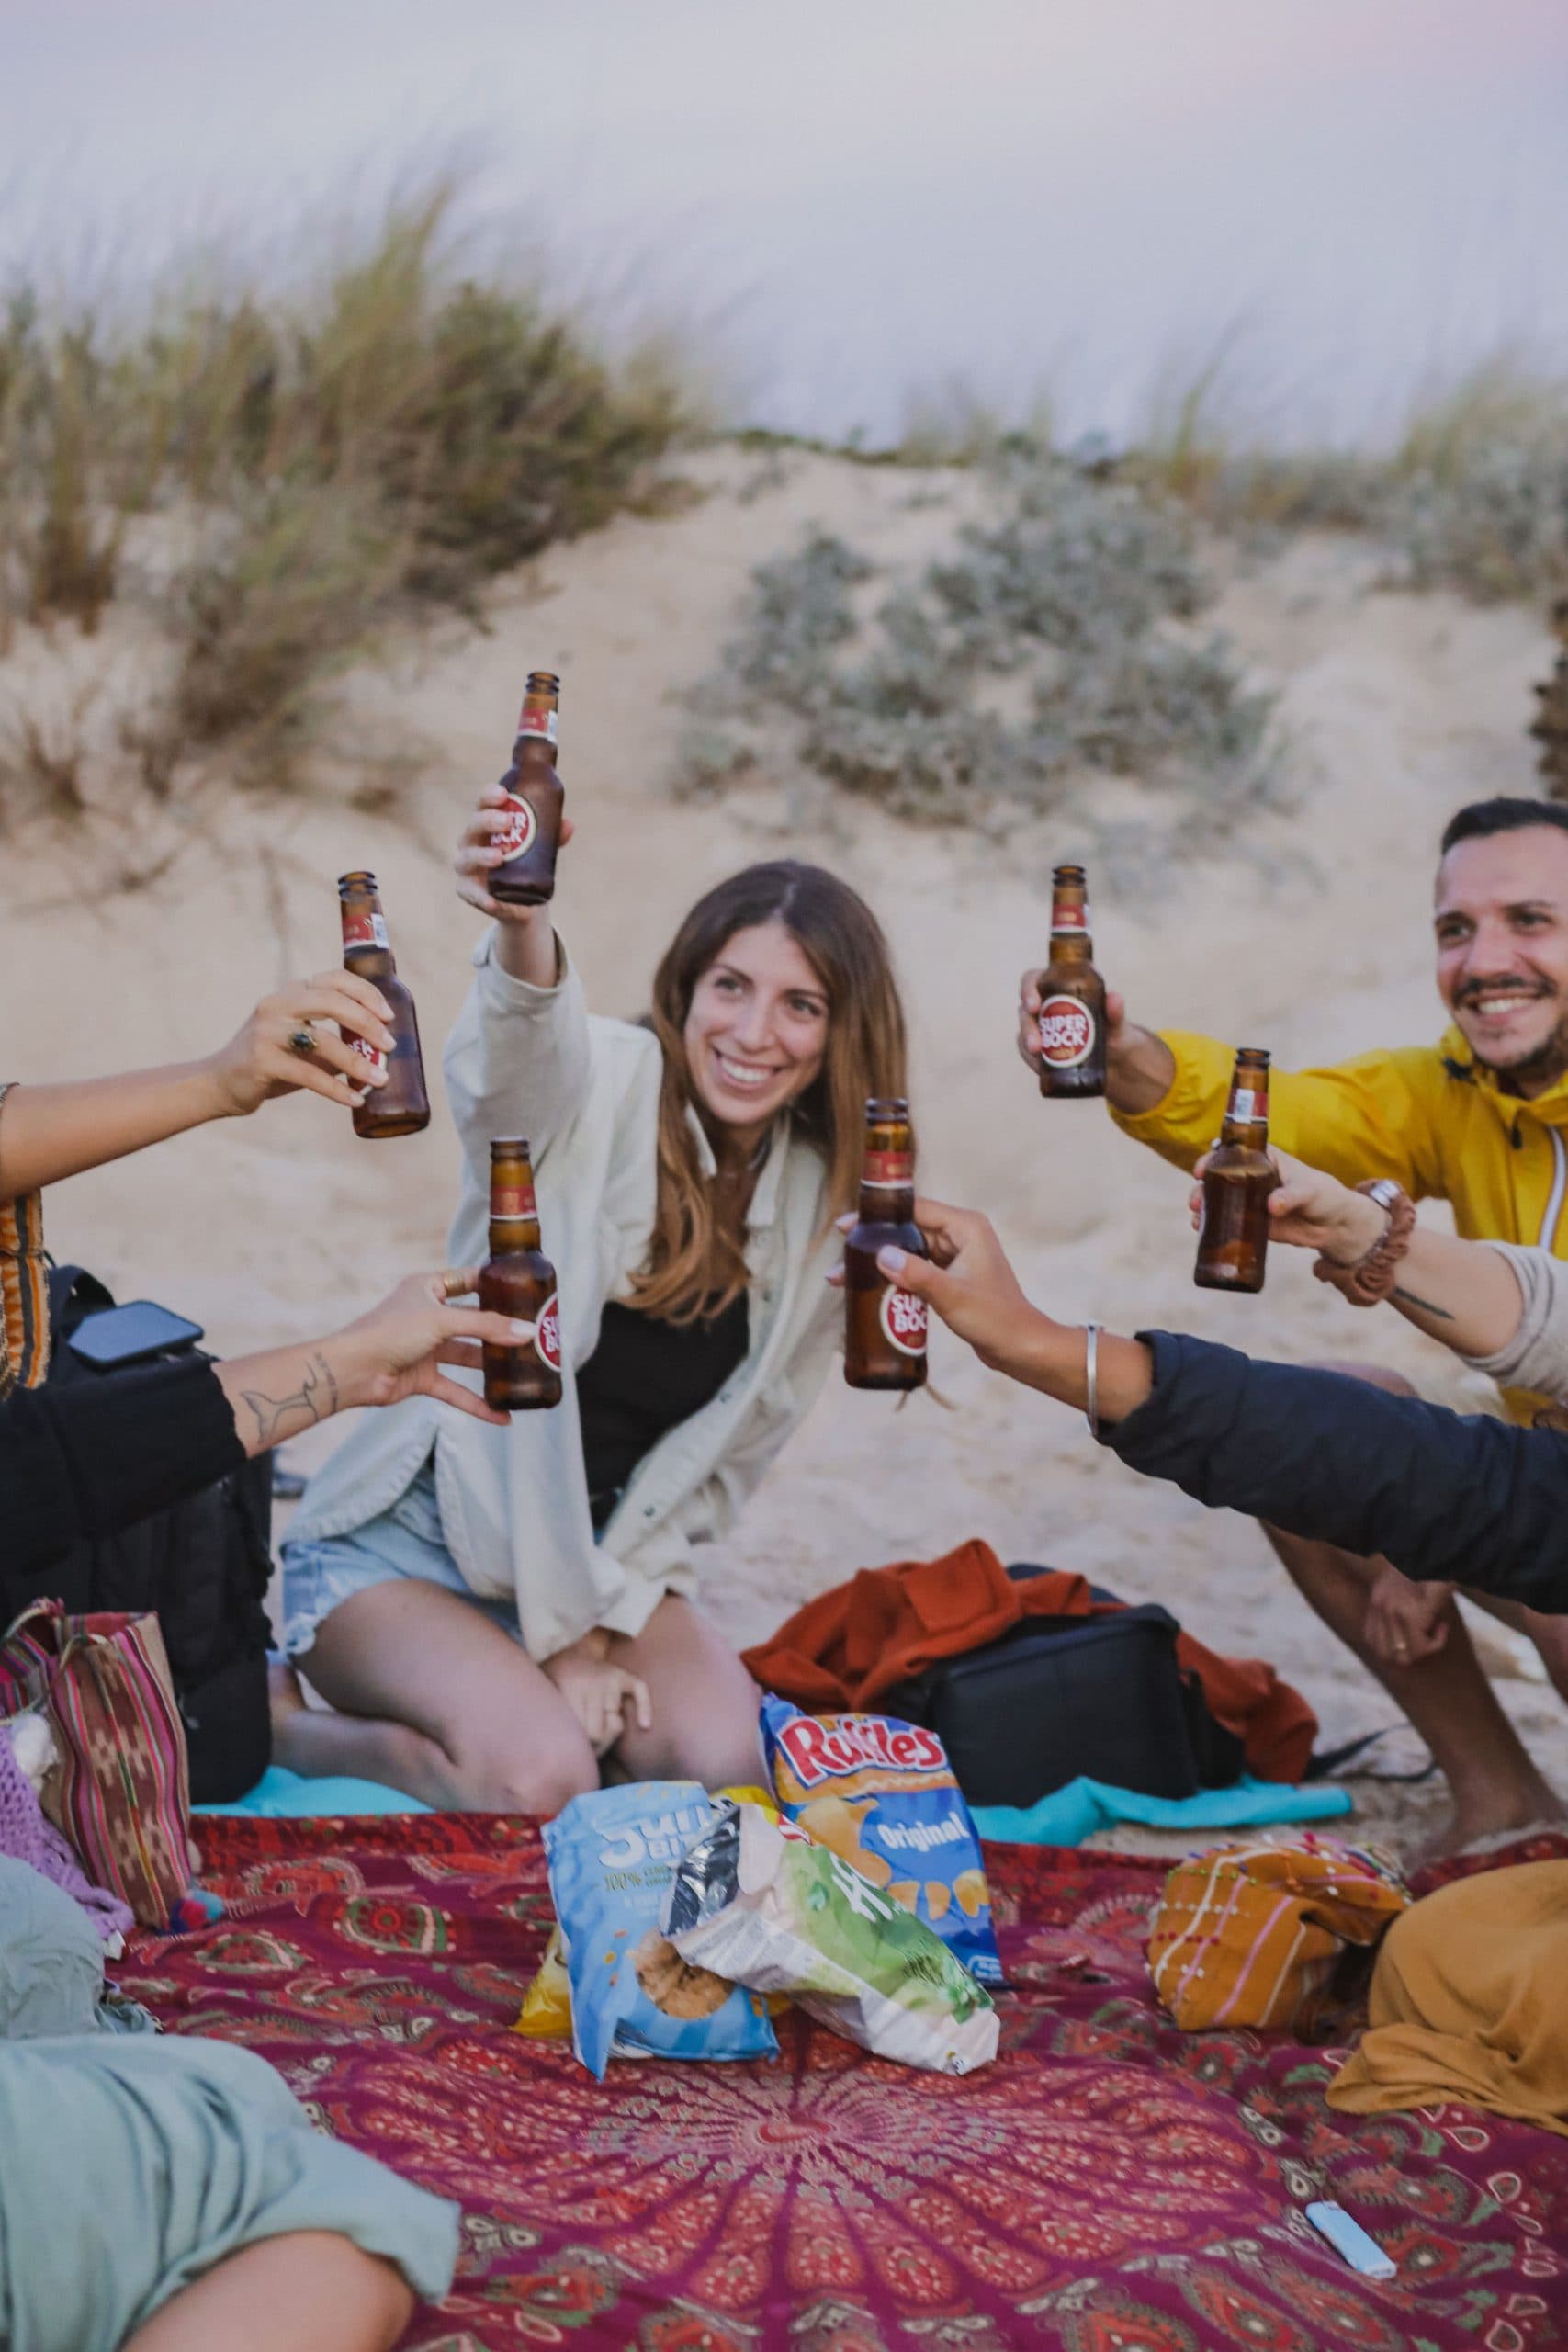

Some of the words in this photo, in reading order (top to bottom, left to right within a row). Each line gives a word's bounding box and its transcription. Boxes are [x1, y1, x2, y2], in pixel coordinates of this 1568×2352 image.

[1040, 1014, 1086, 1031] SUPER
[778, 1716, 947, 1785] Ruffles
[876, 1811, 970, 1852] Original
